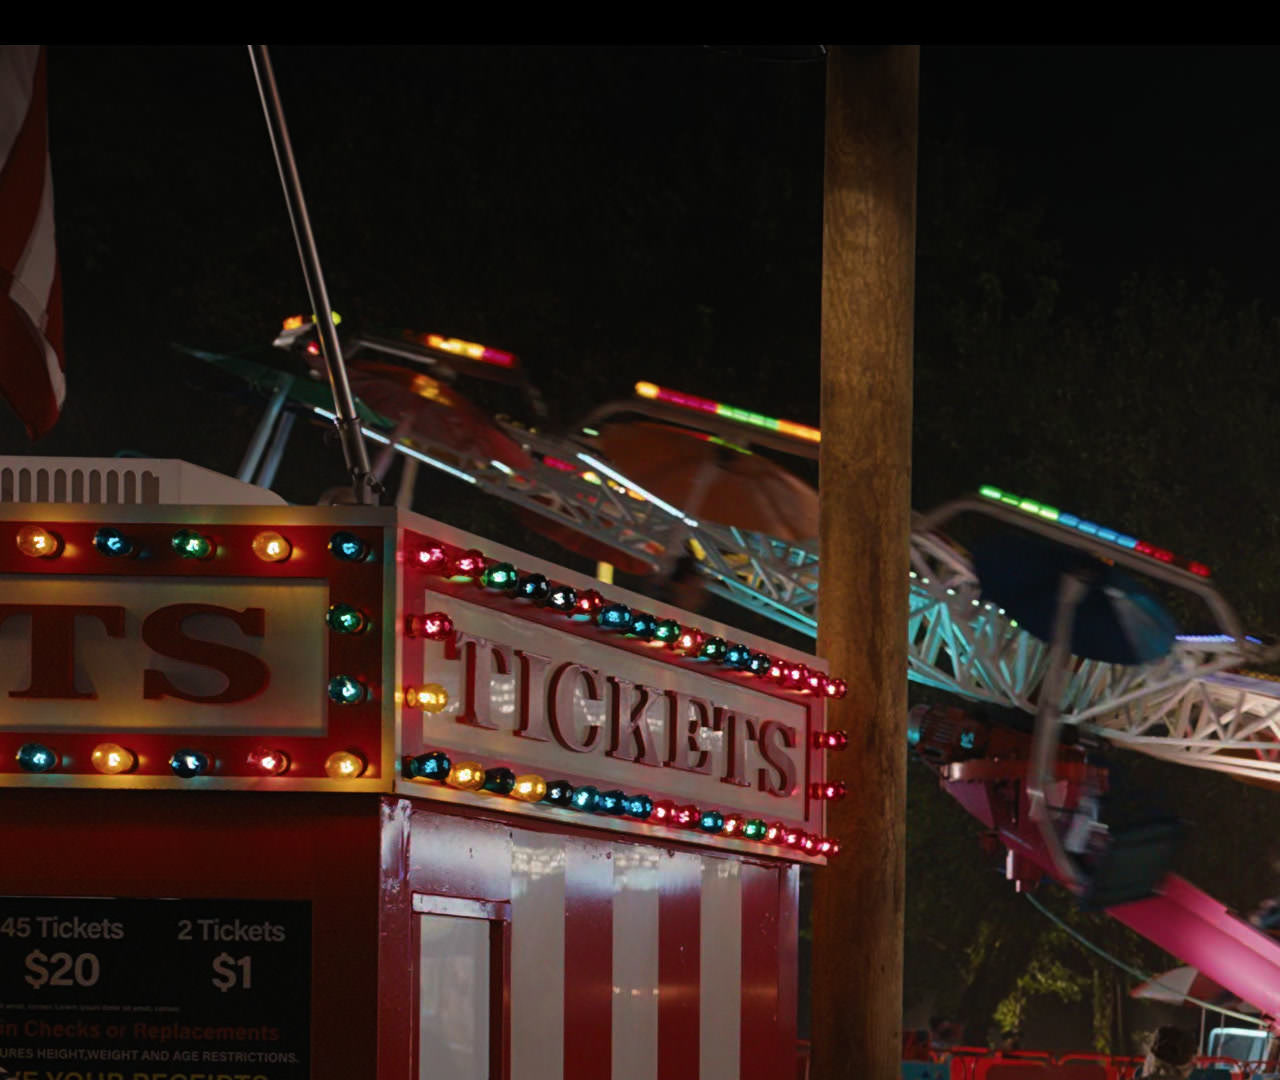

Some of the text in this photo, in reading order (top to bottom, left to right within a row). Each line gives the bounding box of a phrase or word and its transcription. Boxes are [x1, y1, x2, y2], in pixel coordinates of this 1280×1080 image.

[444, 630, 797, 797] TICKETS
[0, 915, 125, 939] 45 Tickets
[177, 917, 287, 942] 2 Tickets
[24, 948, 101, 990] $20
[211, 952, 252, 992] $1
[24, 1018, 101, 1038] Checks
[106, 1024, 128, 1038] or
[133, 1021, 280, 1044] Replacements
[141, 1050, 170, 1062] AND
[172, 1050, 200, 1062] AGE
